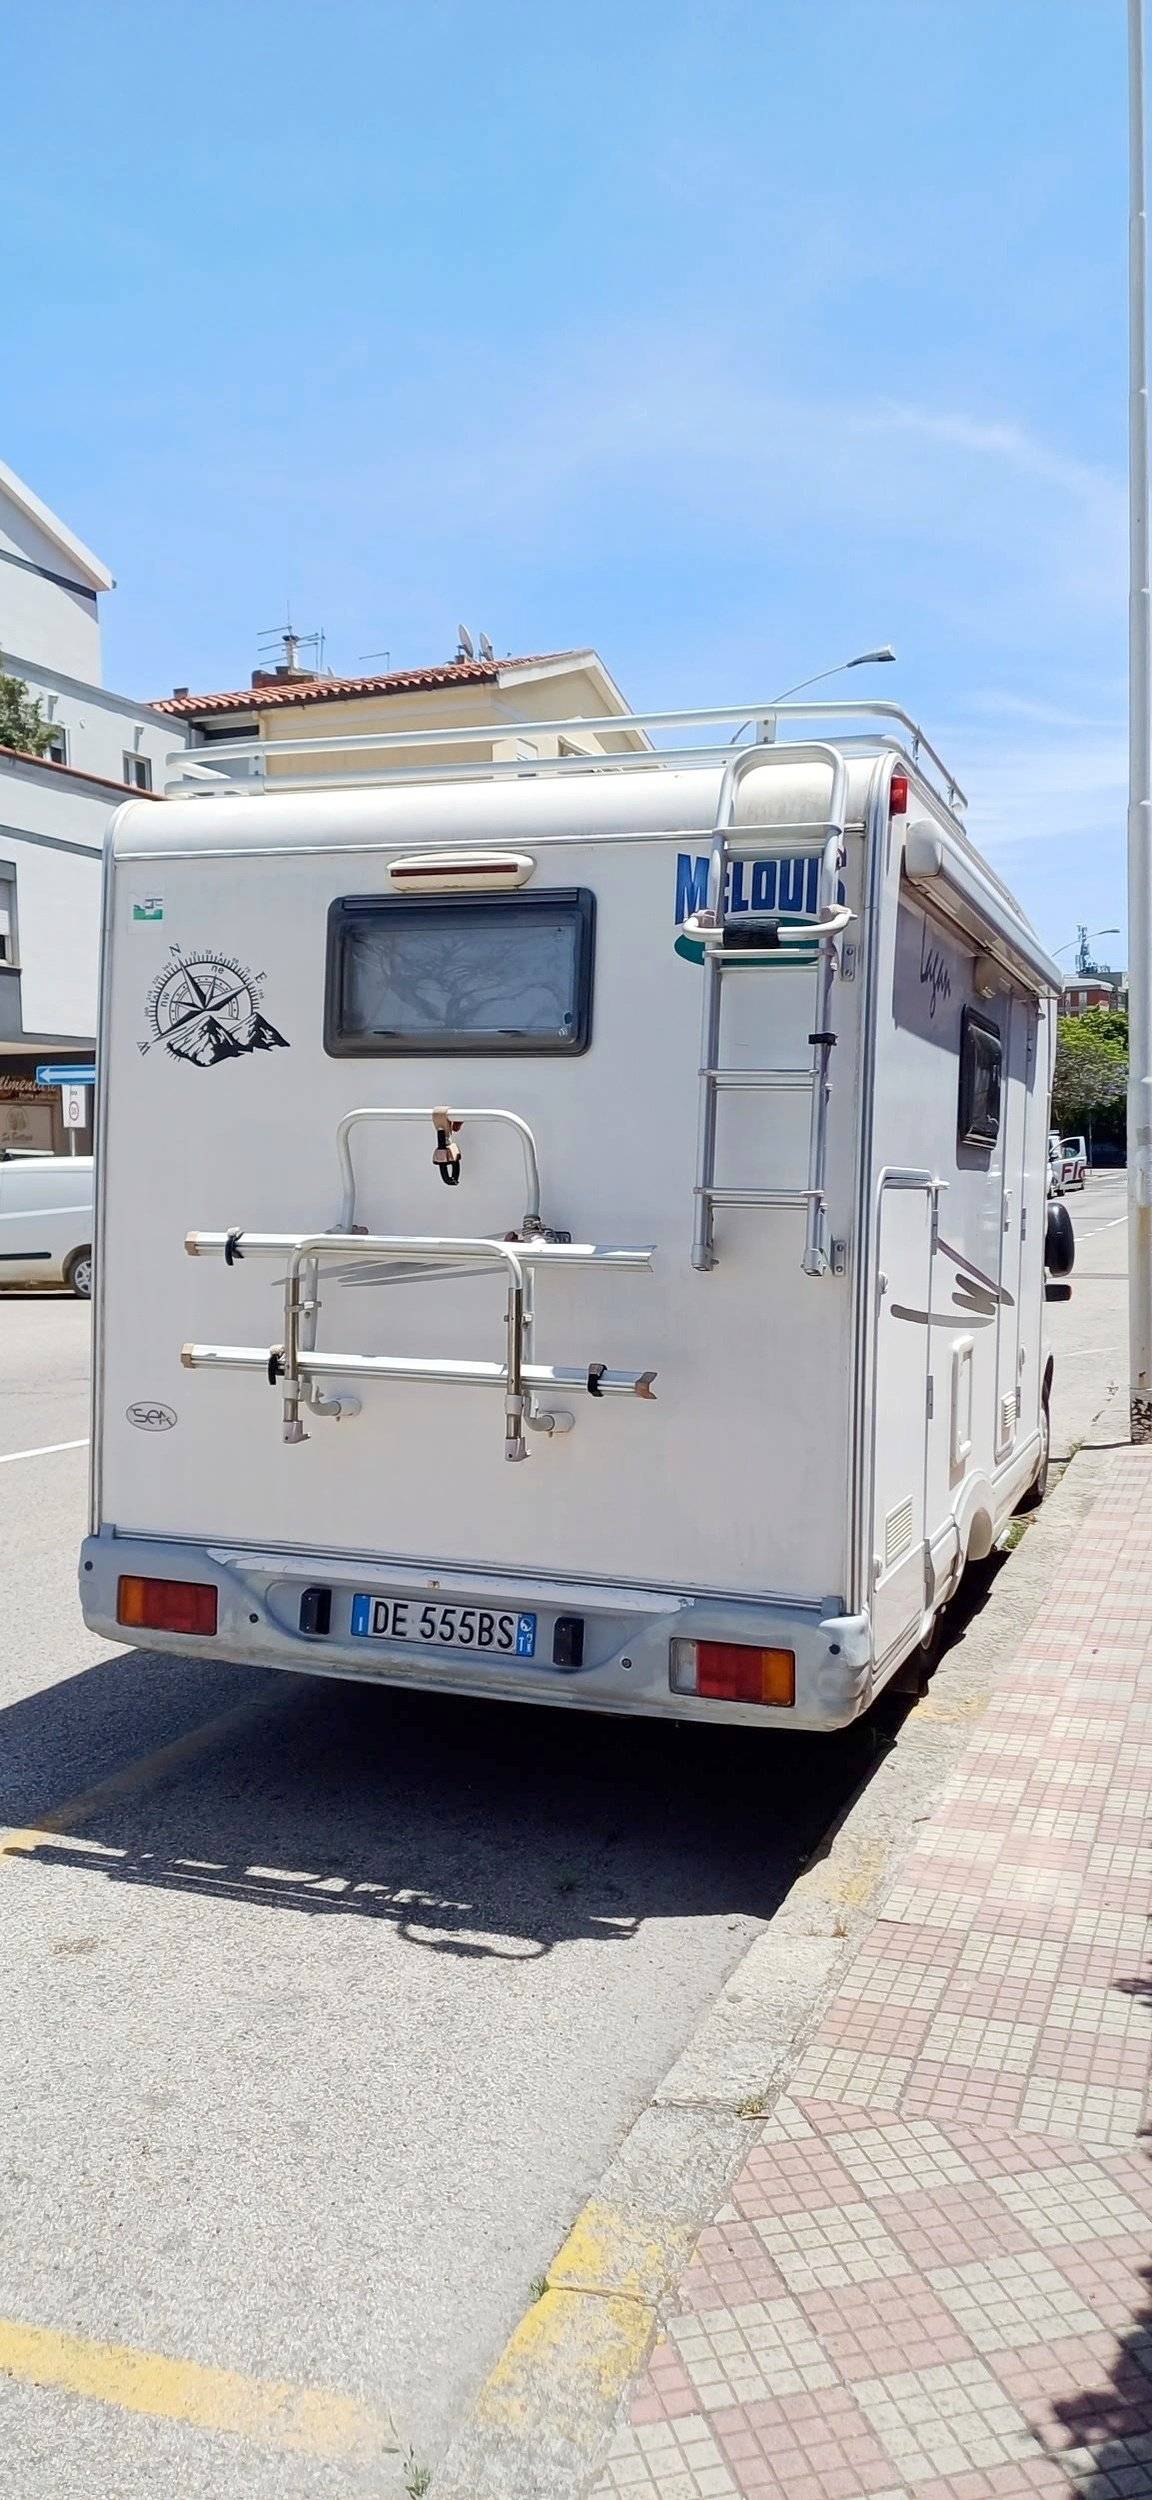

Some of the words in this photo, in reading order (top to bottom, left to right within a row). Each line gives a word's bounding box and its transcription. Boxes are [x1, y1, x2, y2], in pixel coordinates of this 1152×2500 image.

[168, 943, 182, 957] N
[210, 964, 225, 975] ne
[254, 971, 268, 985] E
[373, 1601, 409, 1637] DE
[420, 1607, 514, 1649] 555BS
